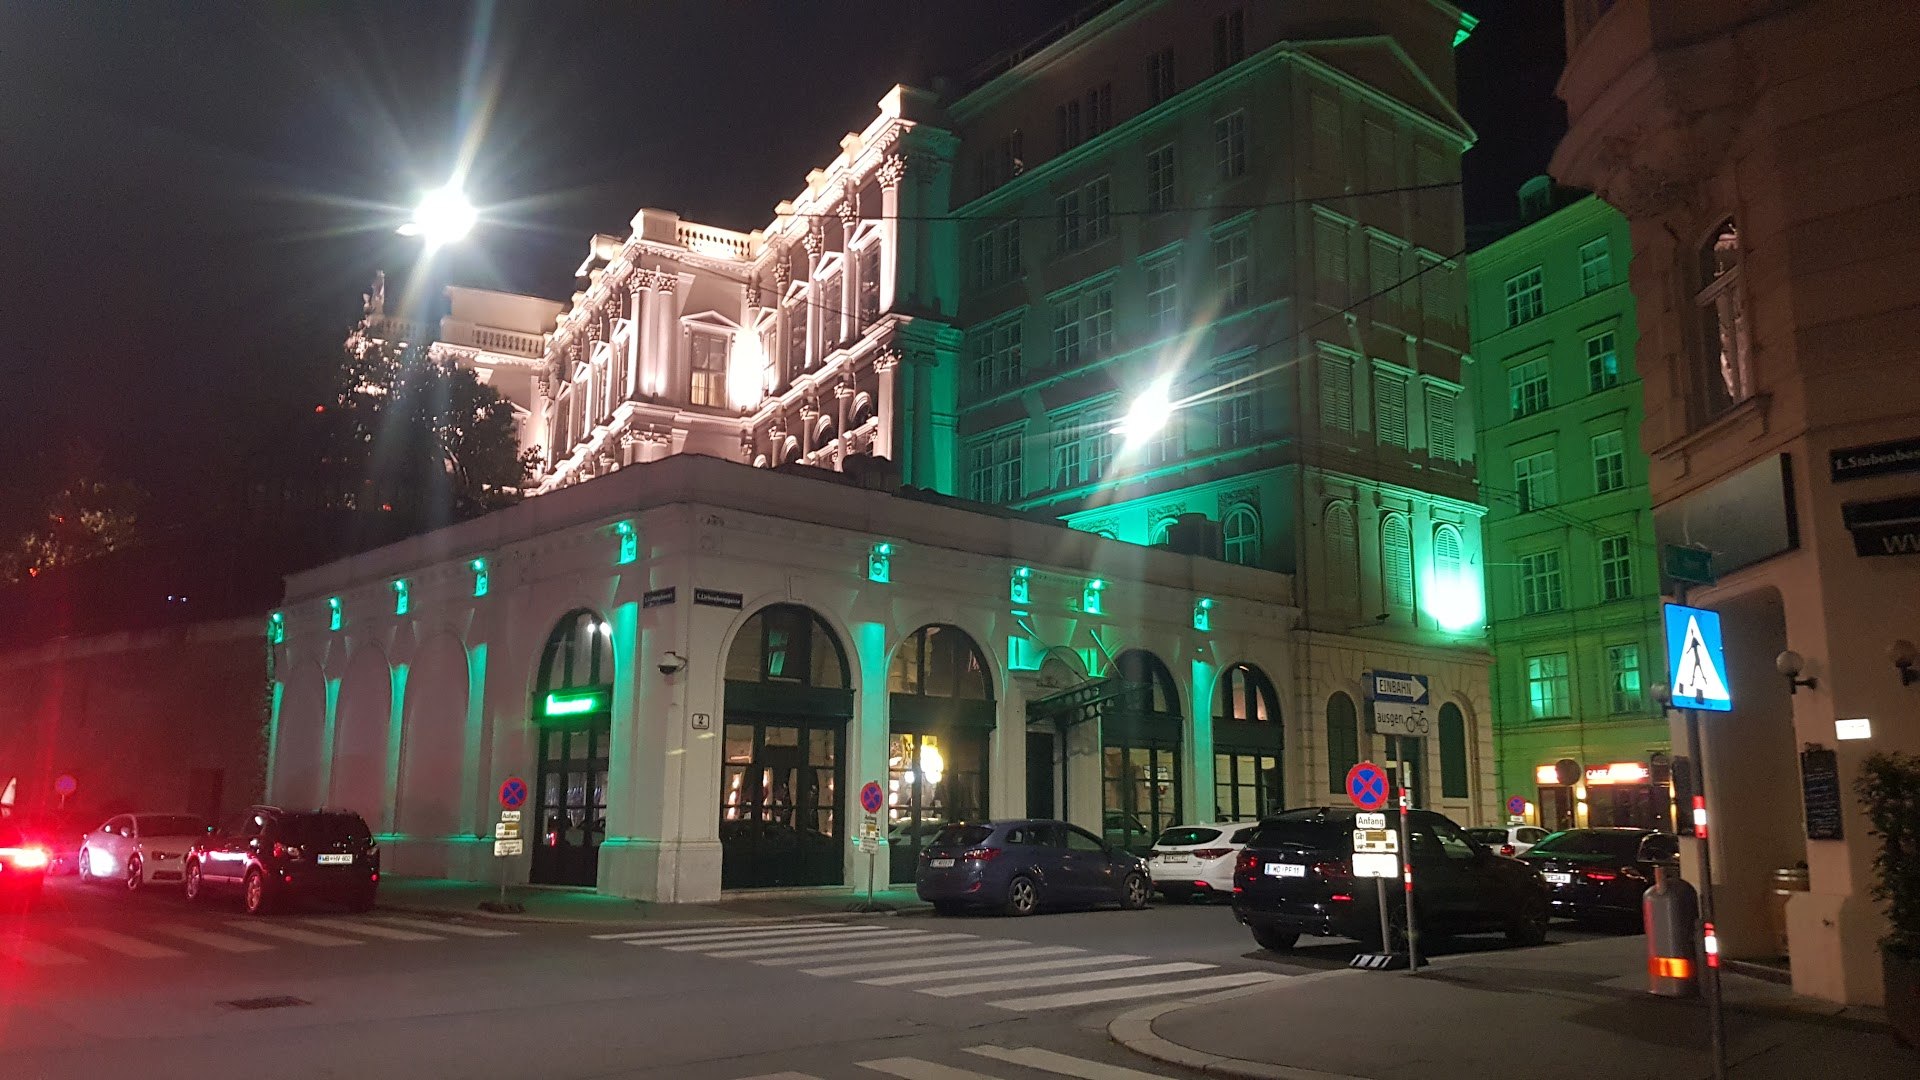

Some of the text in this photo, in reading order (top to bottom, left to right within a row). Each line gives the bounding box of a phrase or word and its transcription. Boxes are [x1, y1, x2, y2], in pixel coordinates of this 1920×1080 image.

[1379, 679, 1412, 695] EINBAHN
[698, 714, 704, 725] 2
[1358, 816, 1384, 827] Anfang
